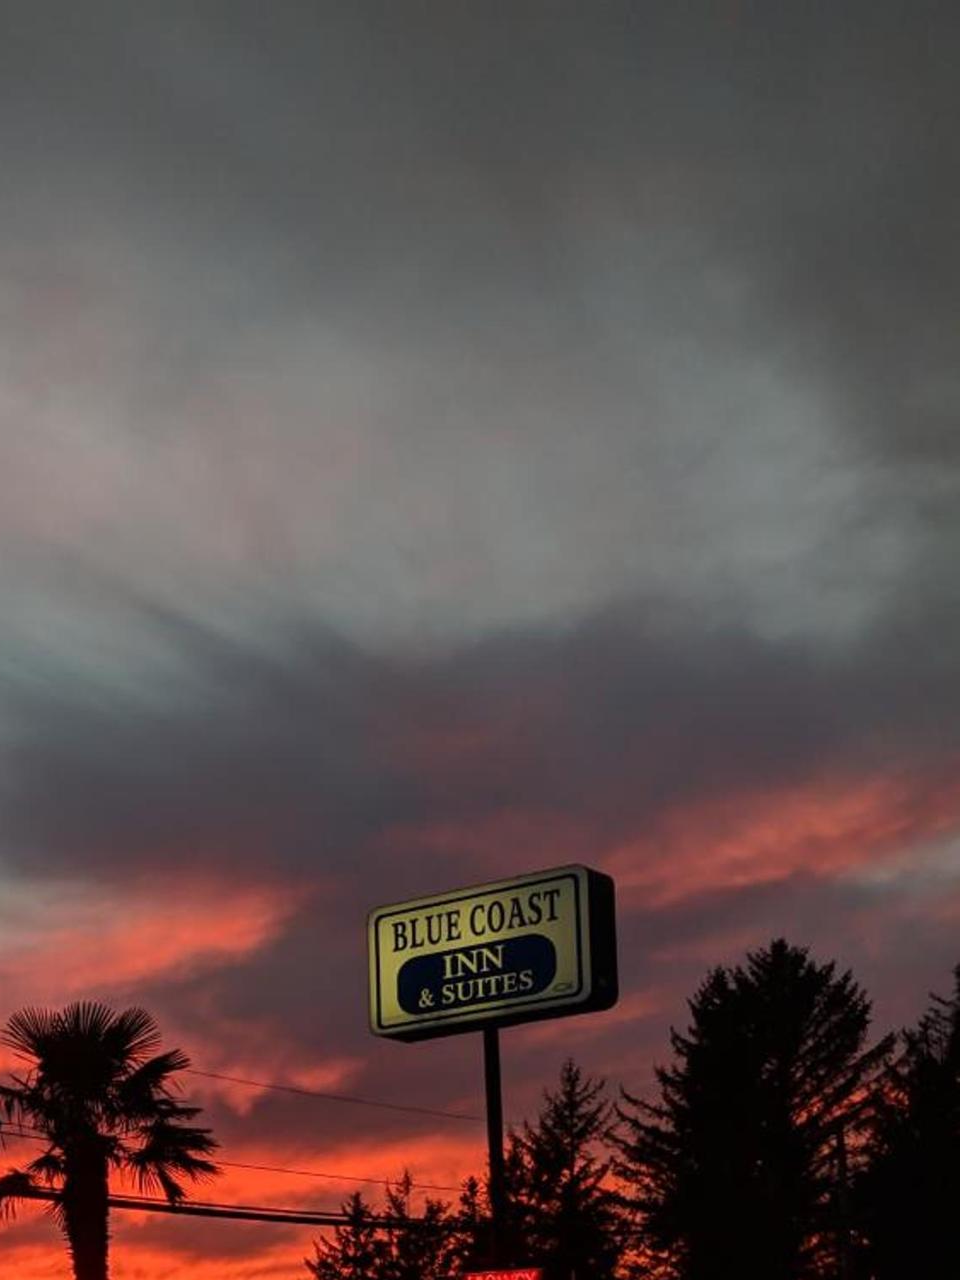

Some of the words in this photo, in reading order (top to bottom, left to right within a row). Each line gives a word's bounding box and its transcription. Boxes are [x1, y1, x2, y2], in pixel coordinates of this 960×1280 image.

[392, 910, 461, 953] BLUE
[470, 889, 560, 937] COAST
[443, 944, 504, 979] INN
[418, 988, 435, 1008] &
[441, 970, 533, 1004] SUITES
